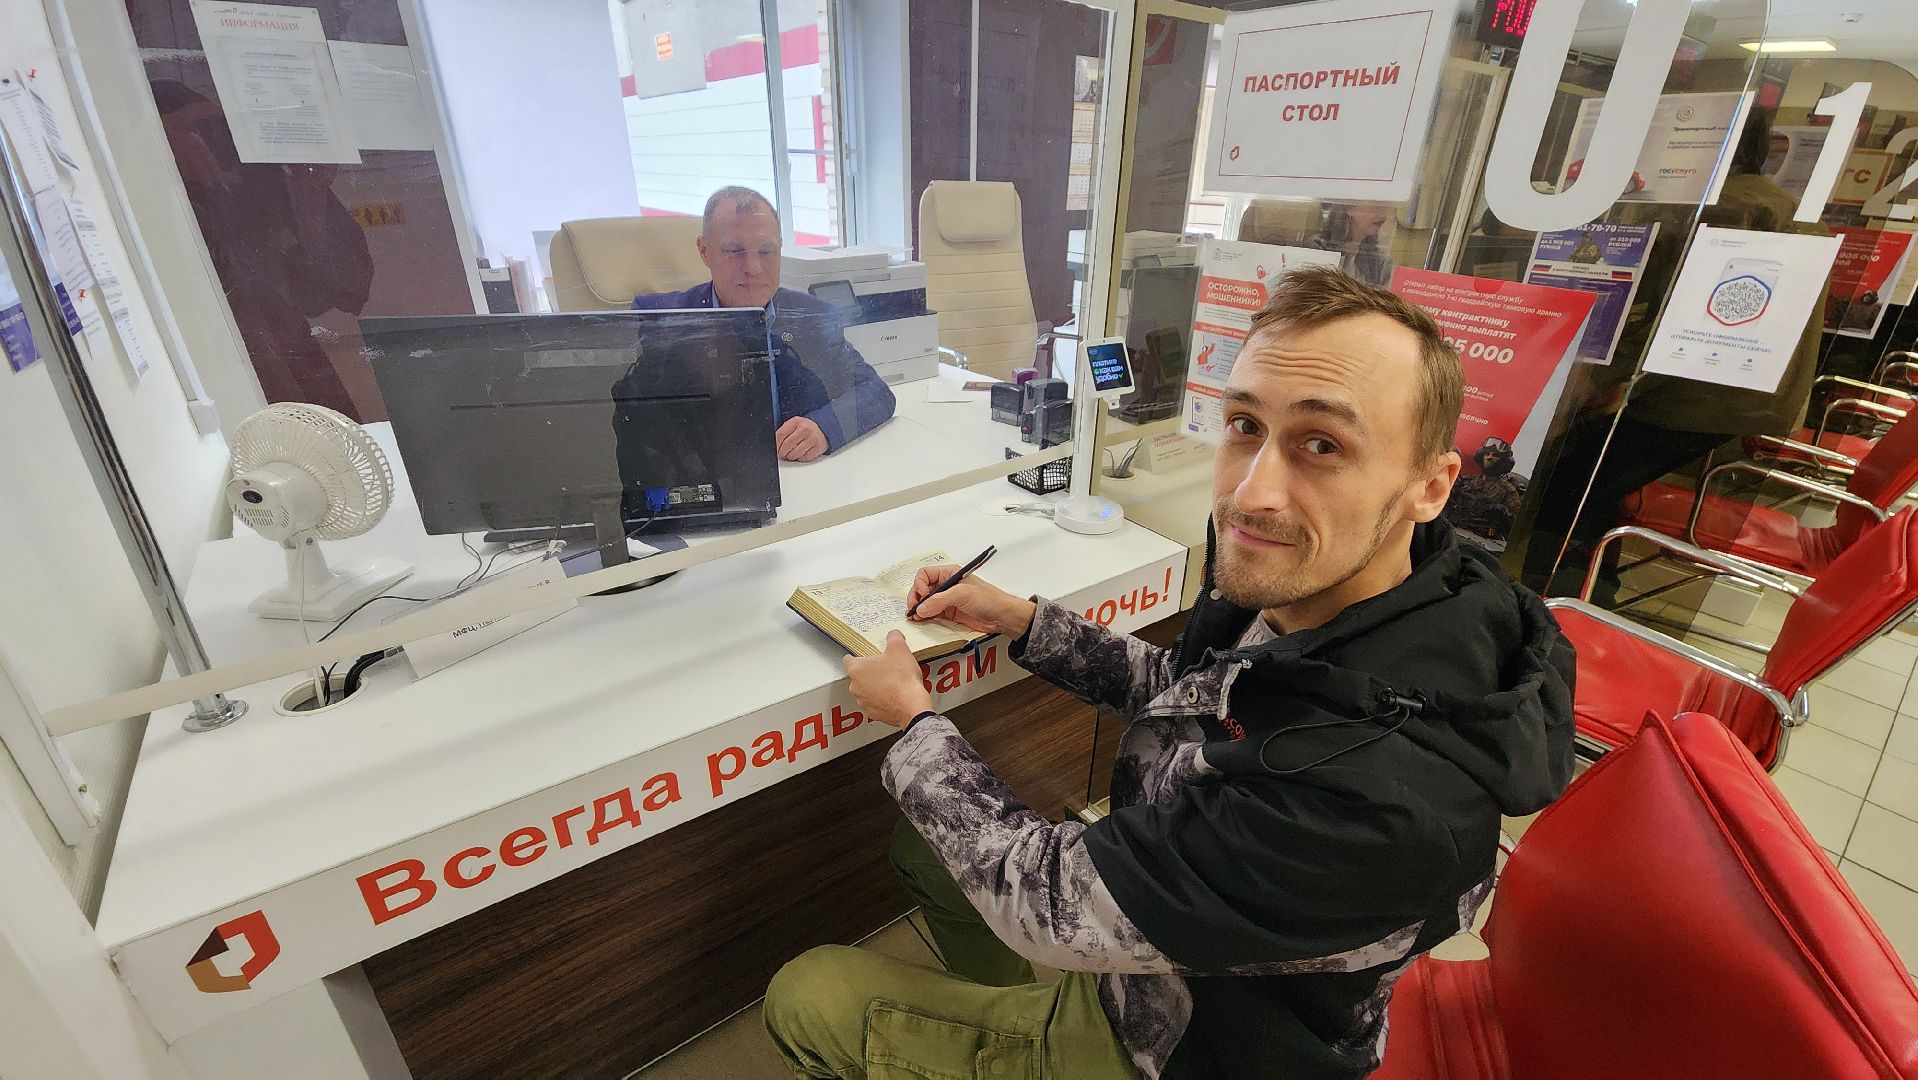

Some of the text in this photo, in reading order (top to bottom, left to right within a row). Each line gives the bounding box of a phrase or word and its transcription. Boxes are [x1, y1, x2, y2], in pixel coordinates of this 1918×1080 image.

[221, 17, 299, 31] ИНФОРМАЦИЯ
[1243, 61, 1401, 94] ПАСПОРТНЫЙ
[1282, 103, 1340, 122] СТОЛ
[1792, 81, 1872, 223] 1
[1206, 292, 1261, 306] МОШЕННИКИ!
[1207, 282, 1260, 297] ОСТОРОЖНО,
[1403, 279, 1426, 290] Открыт
[1426, 283, 1446, 292] набор
[1454, 287, 1496, 300] контрактную
[1496, 293, 1525, 305] службу
[1406, 287, 1446, 300] легендарную
[1457, 296, 1501, 308] гвардейскую
[1501, 303, 1536, 314] танковую
[1440, 309, 1511, 328] контрактнику
[1467, 326, 1517, 340] выплатят
[1092, 359, 1118, 367] платите
[1468, 343, 1514, 364] 000
[1095, 373, 1119, 384] удобно
[1111, 365, 1124, 373] вам
[452, 625, 478, 639] МФЦ,
[706, 705, 874, 799] рады
[355, 770, 684, 926] Всегда
